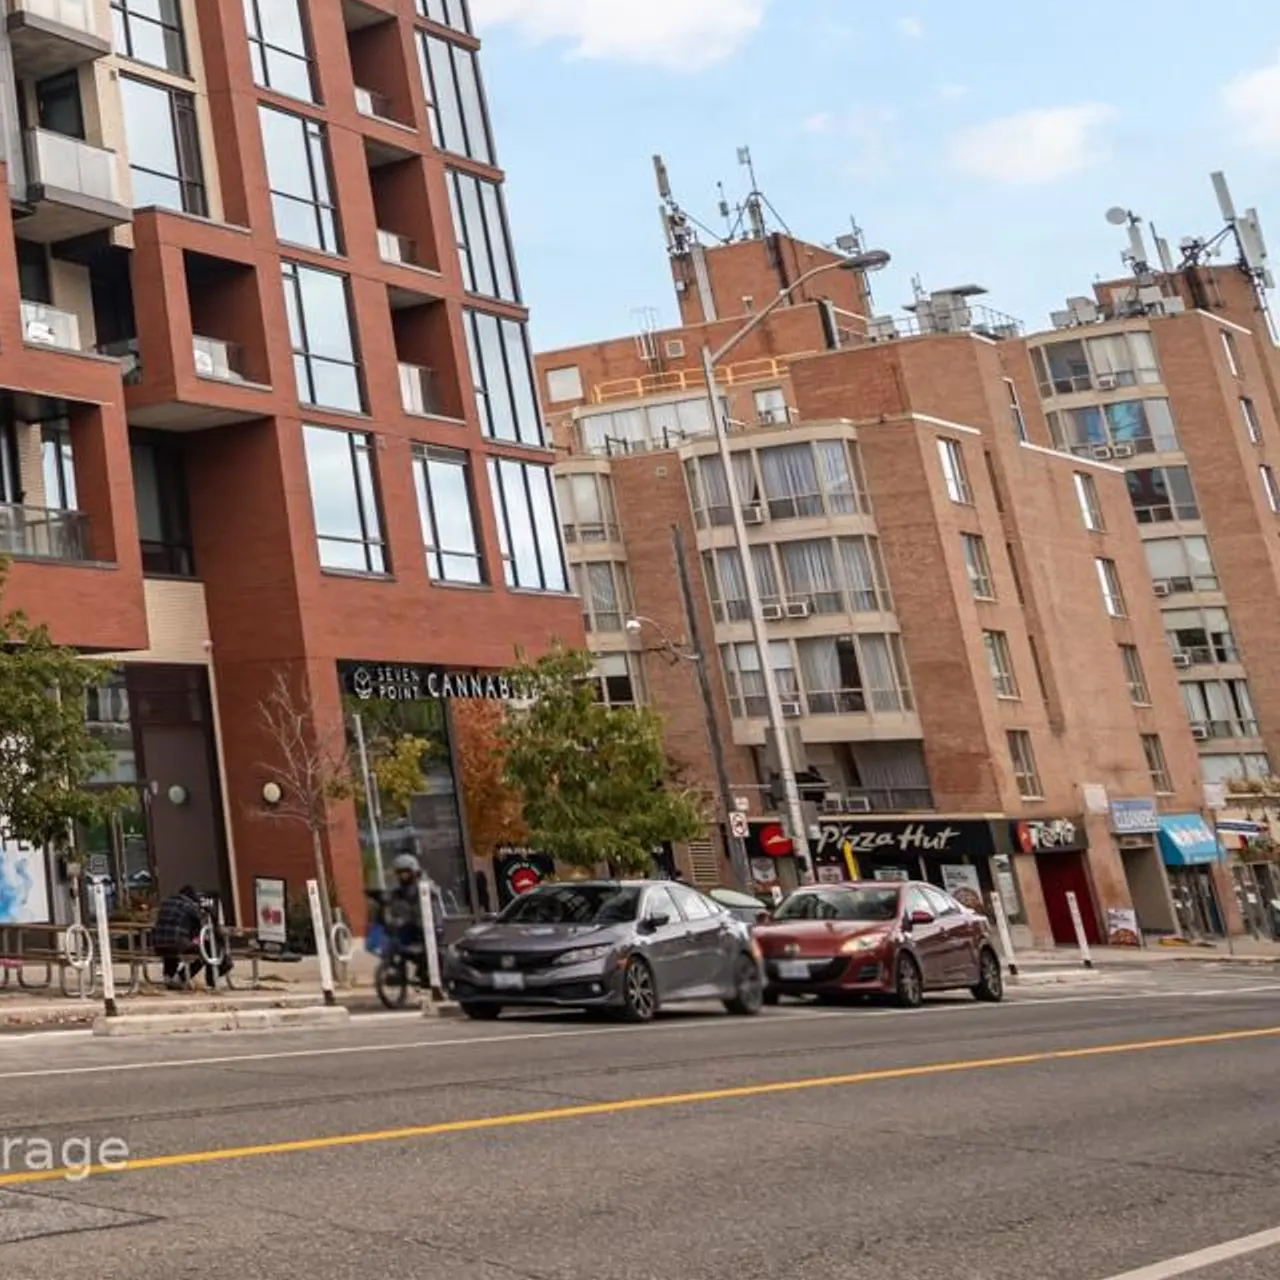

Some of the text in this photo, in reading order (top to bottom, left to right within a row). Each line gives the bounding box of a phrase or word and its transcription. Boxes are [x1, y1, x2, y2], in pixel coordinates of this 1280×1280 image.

[377, 667, 420, 683] SEVEN
[380, 685, 420, 700] POINT
[428, 673, 531, 700] CANNAB
[817, 824, 961, 854] Pizza Hut
